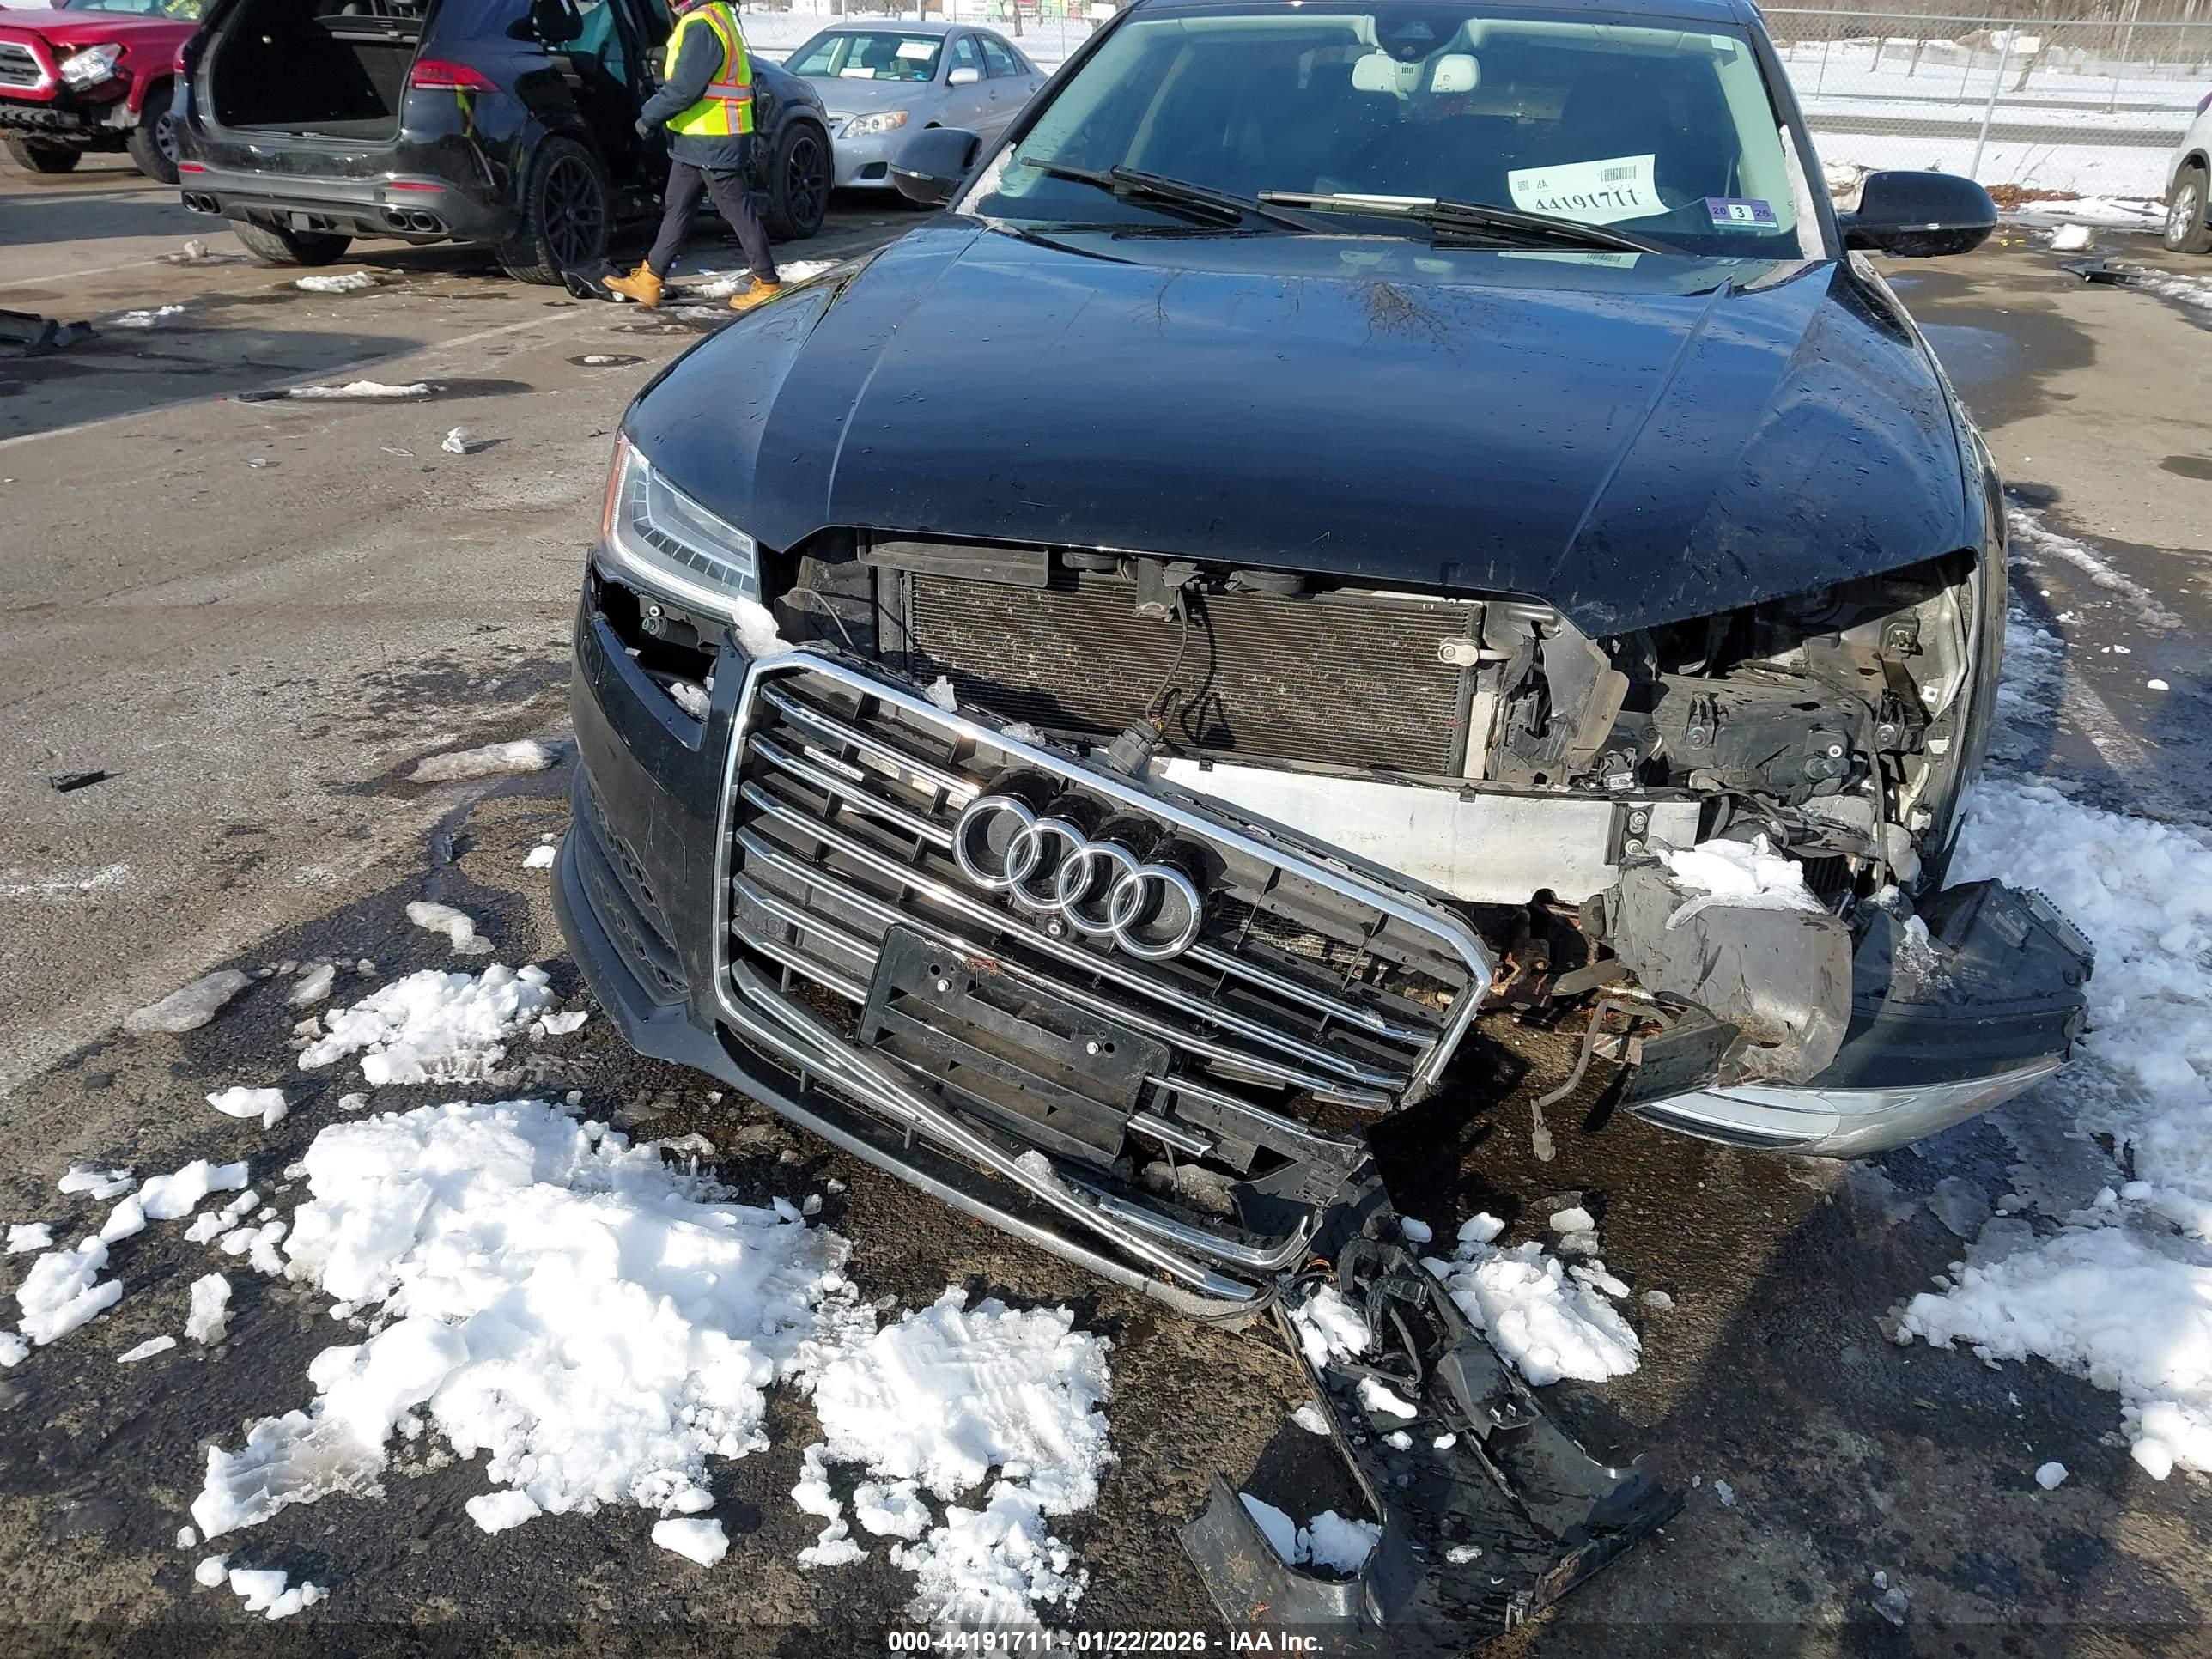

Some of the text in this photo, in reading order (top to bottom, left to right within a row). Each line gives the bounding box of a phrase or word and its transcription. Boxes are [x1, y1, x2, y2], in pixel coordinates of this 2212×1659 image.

[1535, 188, 1641, 210] 44191711
[1712, 205, 1771, 218] 20 3 26
